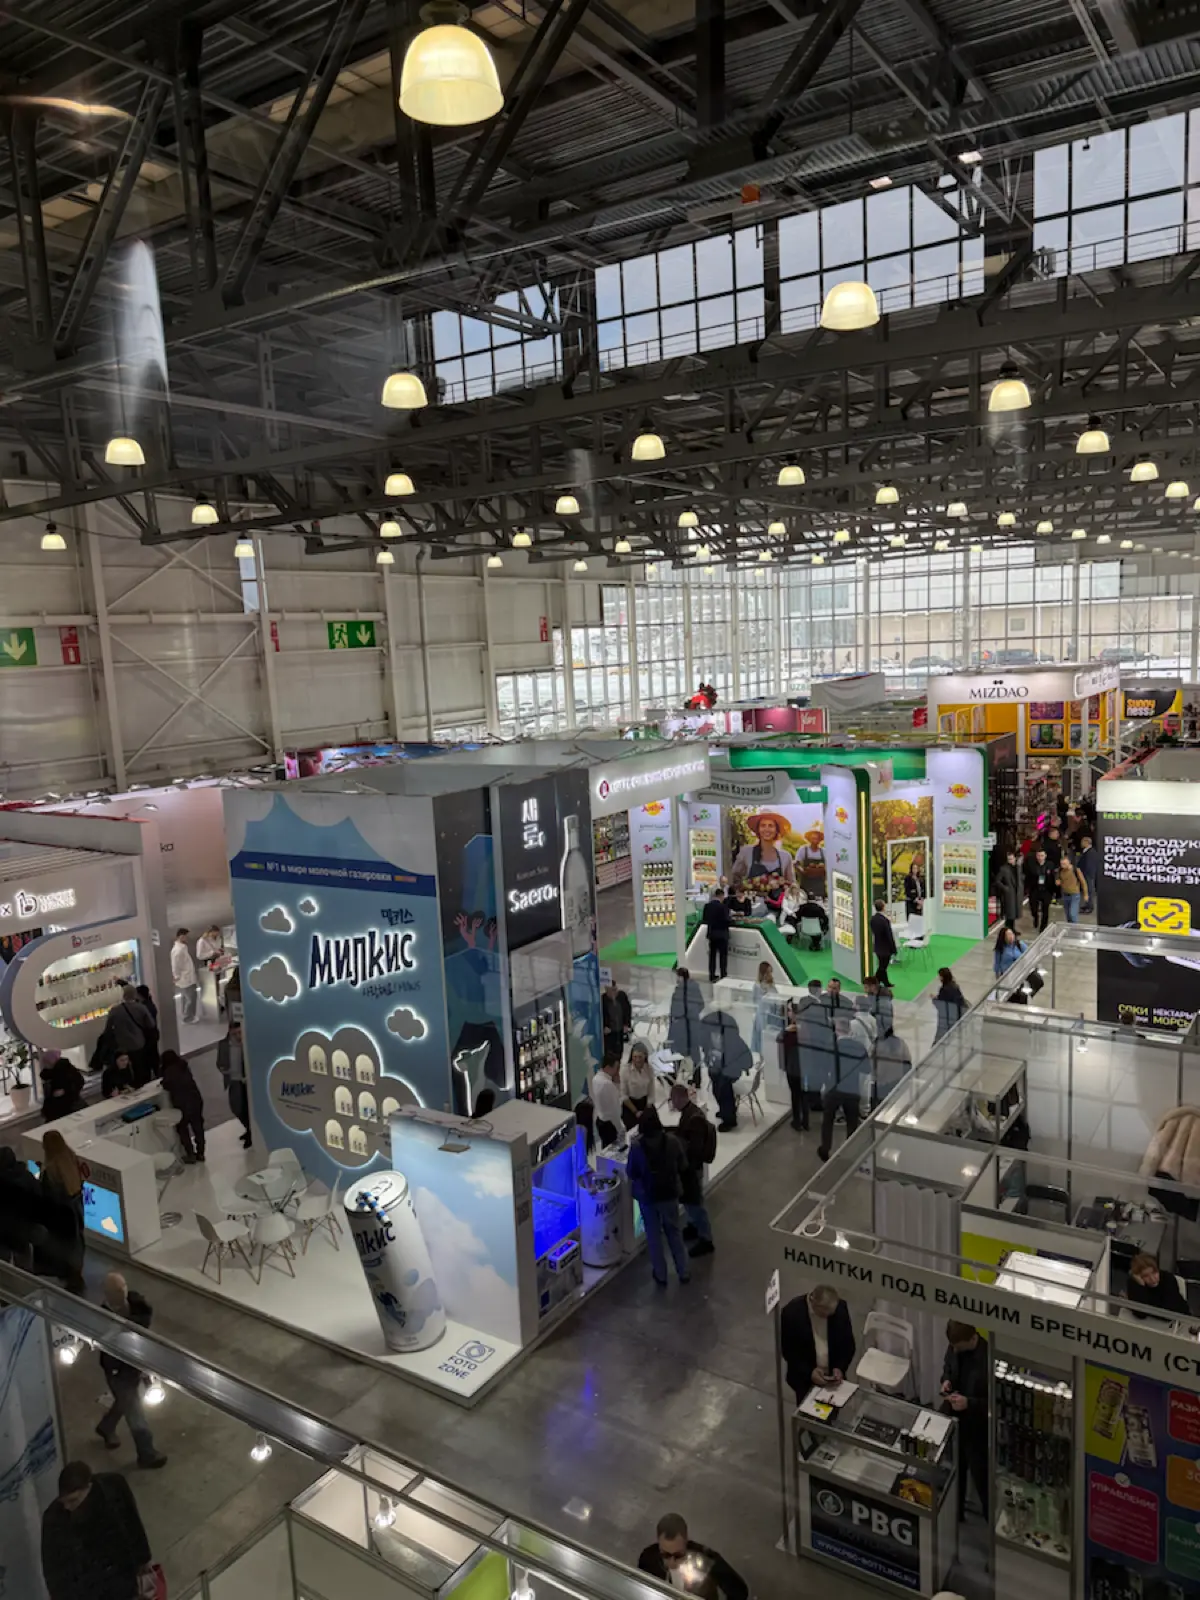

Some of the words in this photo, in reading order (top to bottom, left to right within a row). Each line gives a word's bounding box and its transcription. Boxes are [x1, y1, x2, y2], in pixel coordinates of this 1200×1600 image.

[969, 687, 1029, 699] MIZDAO
[1104, 836, 1132, 845] ВСЯ
[1104, 845, 1186, 857] ПРОХОДИТ
[1104, 854, 1172, 865] СИСТЕМУ
[287, 865, 307, 875] мире
[308, 867, 348, 877] молочной
[348, 870, 392, 882] газировки
[784, 1246, 873, 1283] НАПИТКИ
[881, 1273, 926, 1302] ПОД
[935, 1288, 1020, 1324] ВАШИМ
[1030, 1314, 1153, 1363] БРЕНДОМ
[437, 1362, 470, 1379] ZONE
[448, 1355, 478, 1371] FOTO
[1170, 1400, 1200, 1415] РАЗР
[851, 1500, 913, 1546] PBG
